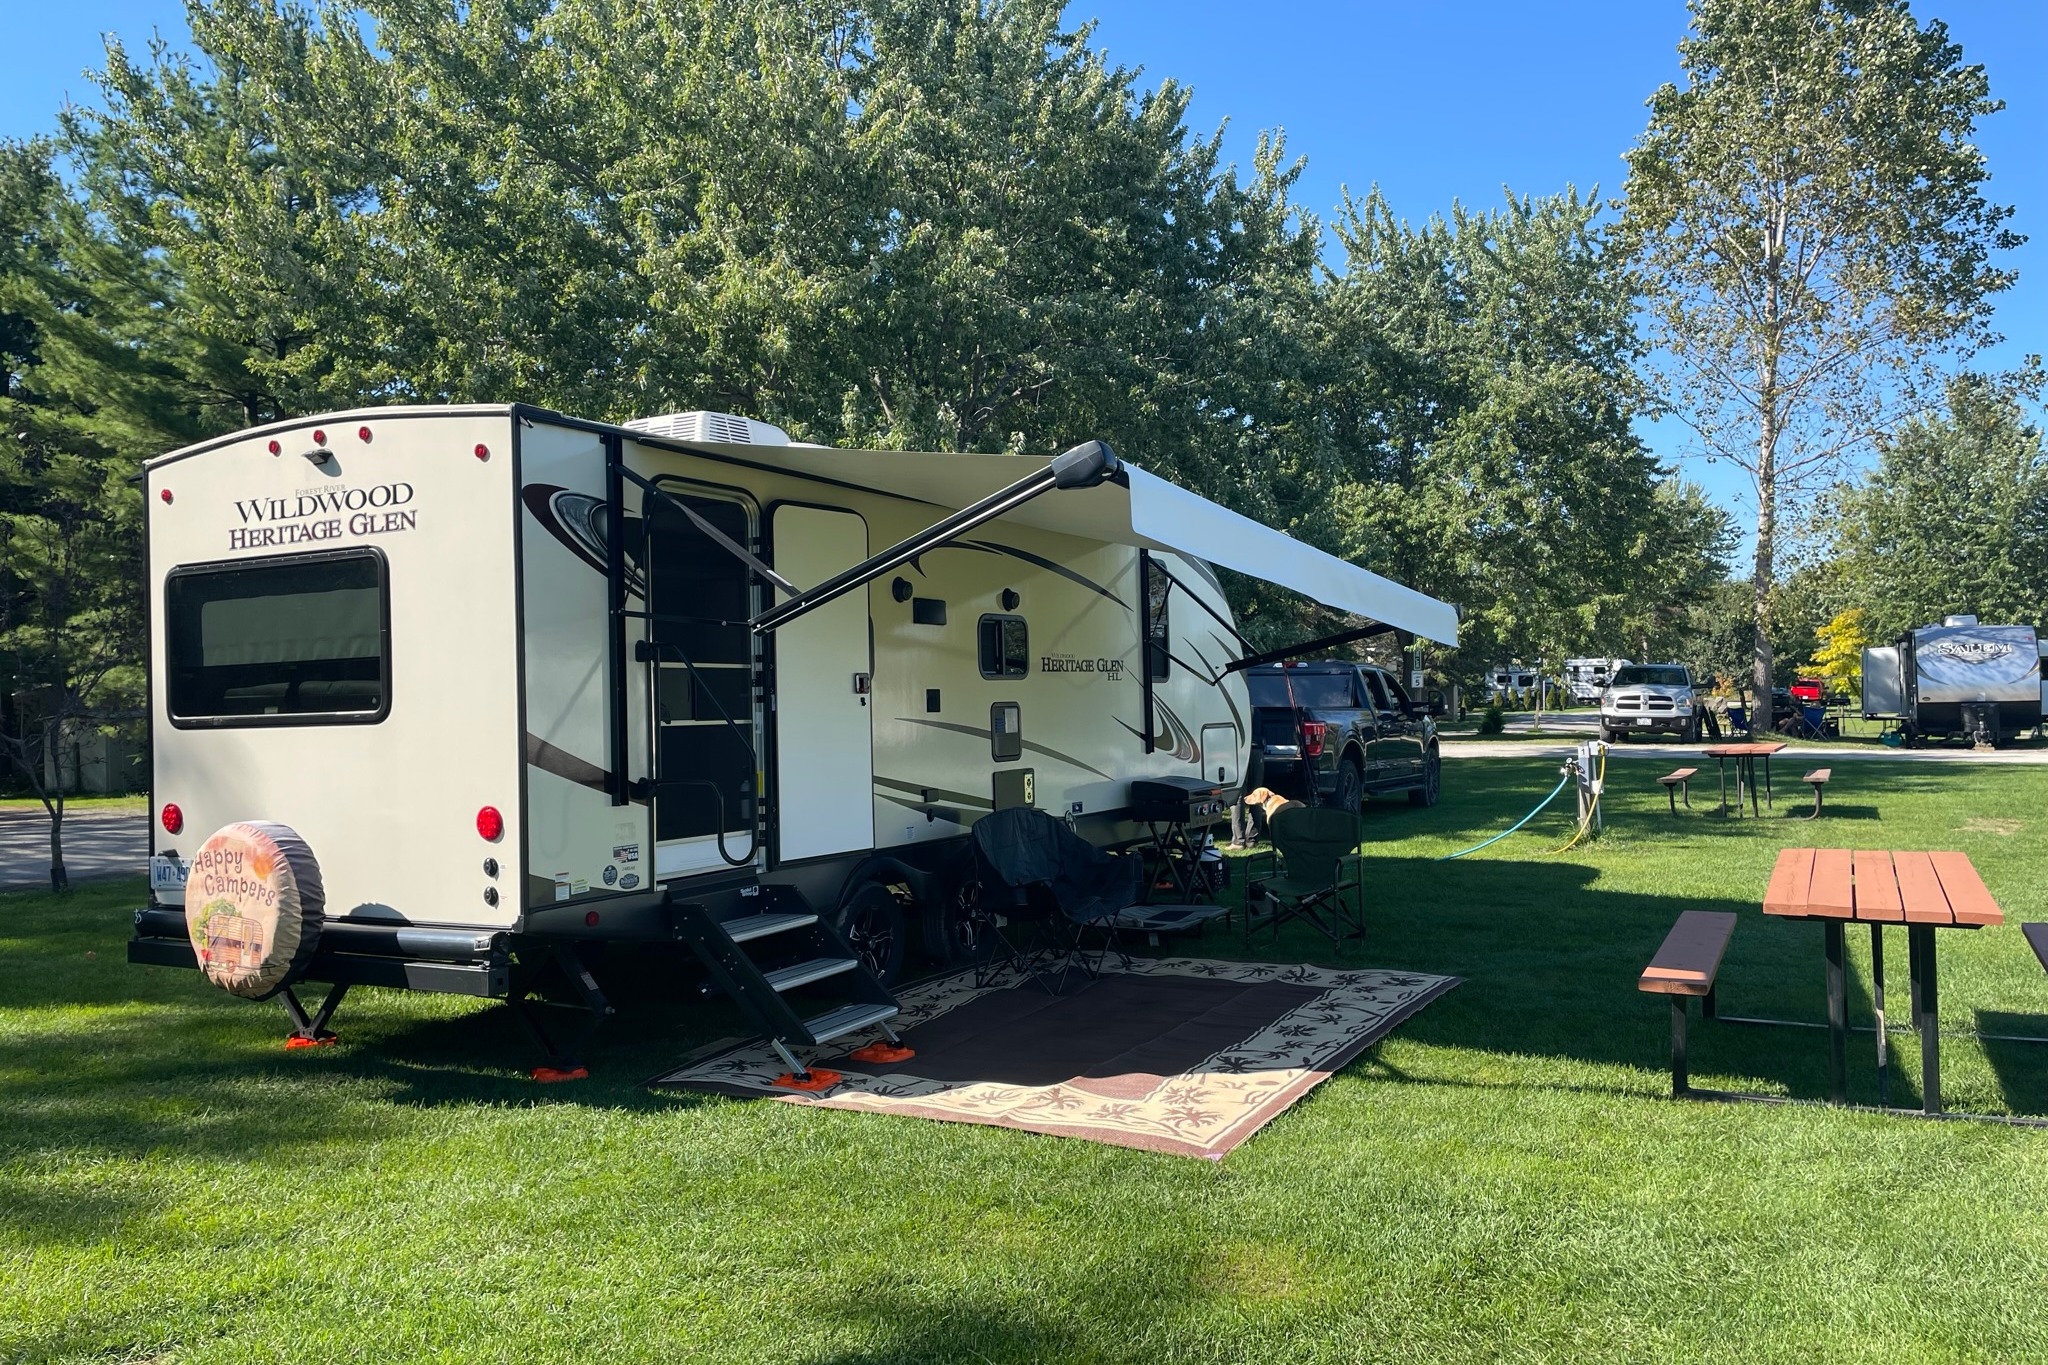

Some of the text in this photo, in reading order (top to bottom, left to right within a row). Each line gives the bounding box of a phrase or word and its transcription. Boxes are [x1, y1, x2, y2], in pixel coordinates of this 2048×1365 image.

[234, 482, 414, 523] WILDWOOD
[229, 509, 418, 551] HERITAGE GLEN
[1937, 642, 2012, 655] SALEM
[1041, 657, 1124, 672] HERITAGE GLEN
[1107, 673, 1122, 681] HL
[1415, 679, 1421, 687] 5
[194, 849, 244, 874] Happy
[204, 874, 276, 906] Campers
